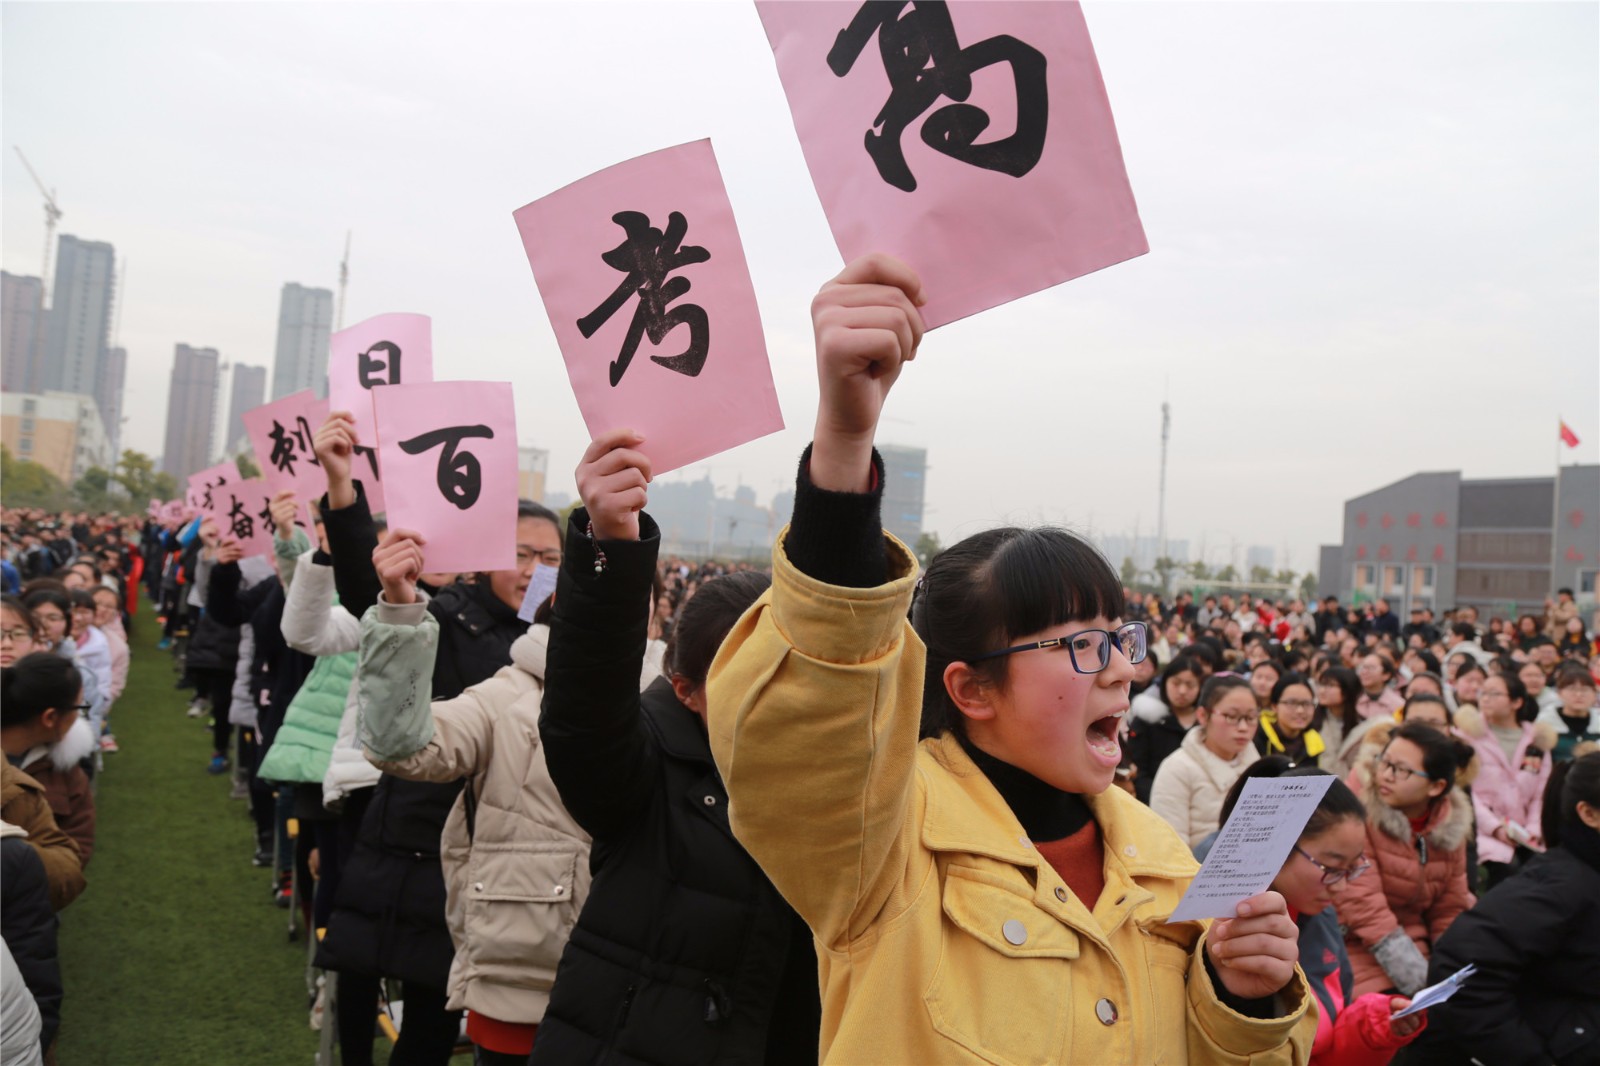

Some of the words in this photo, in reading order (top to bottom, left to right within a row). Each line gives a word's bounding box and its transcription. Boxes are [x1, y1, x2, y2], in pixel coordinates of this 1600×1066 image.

[828, 0, 1048, 192] 高
[576, 211, 711, 387] 考
[358, 340, 402, 389] 日
[268, 416, 320, 476] 刺
[398, 424, 494, 510] 百
[227, 494, 254, 539] 奋
